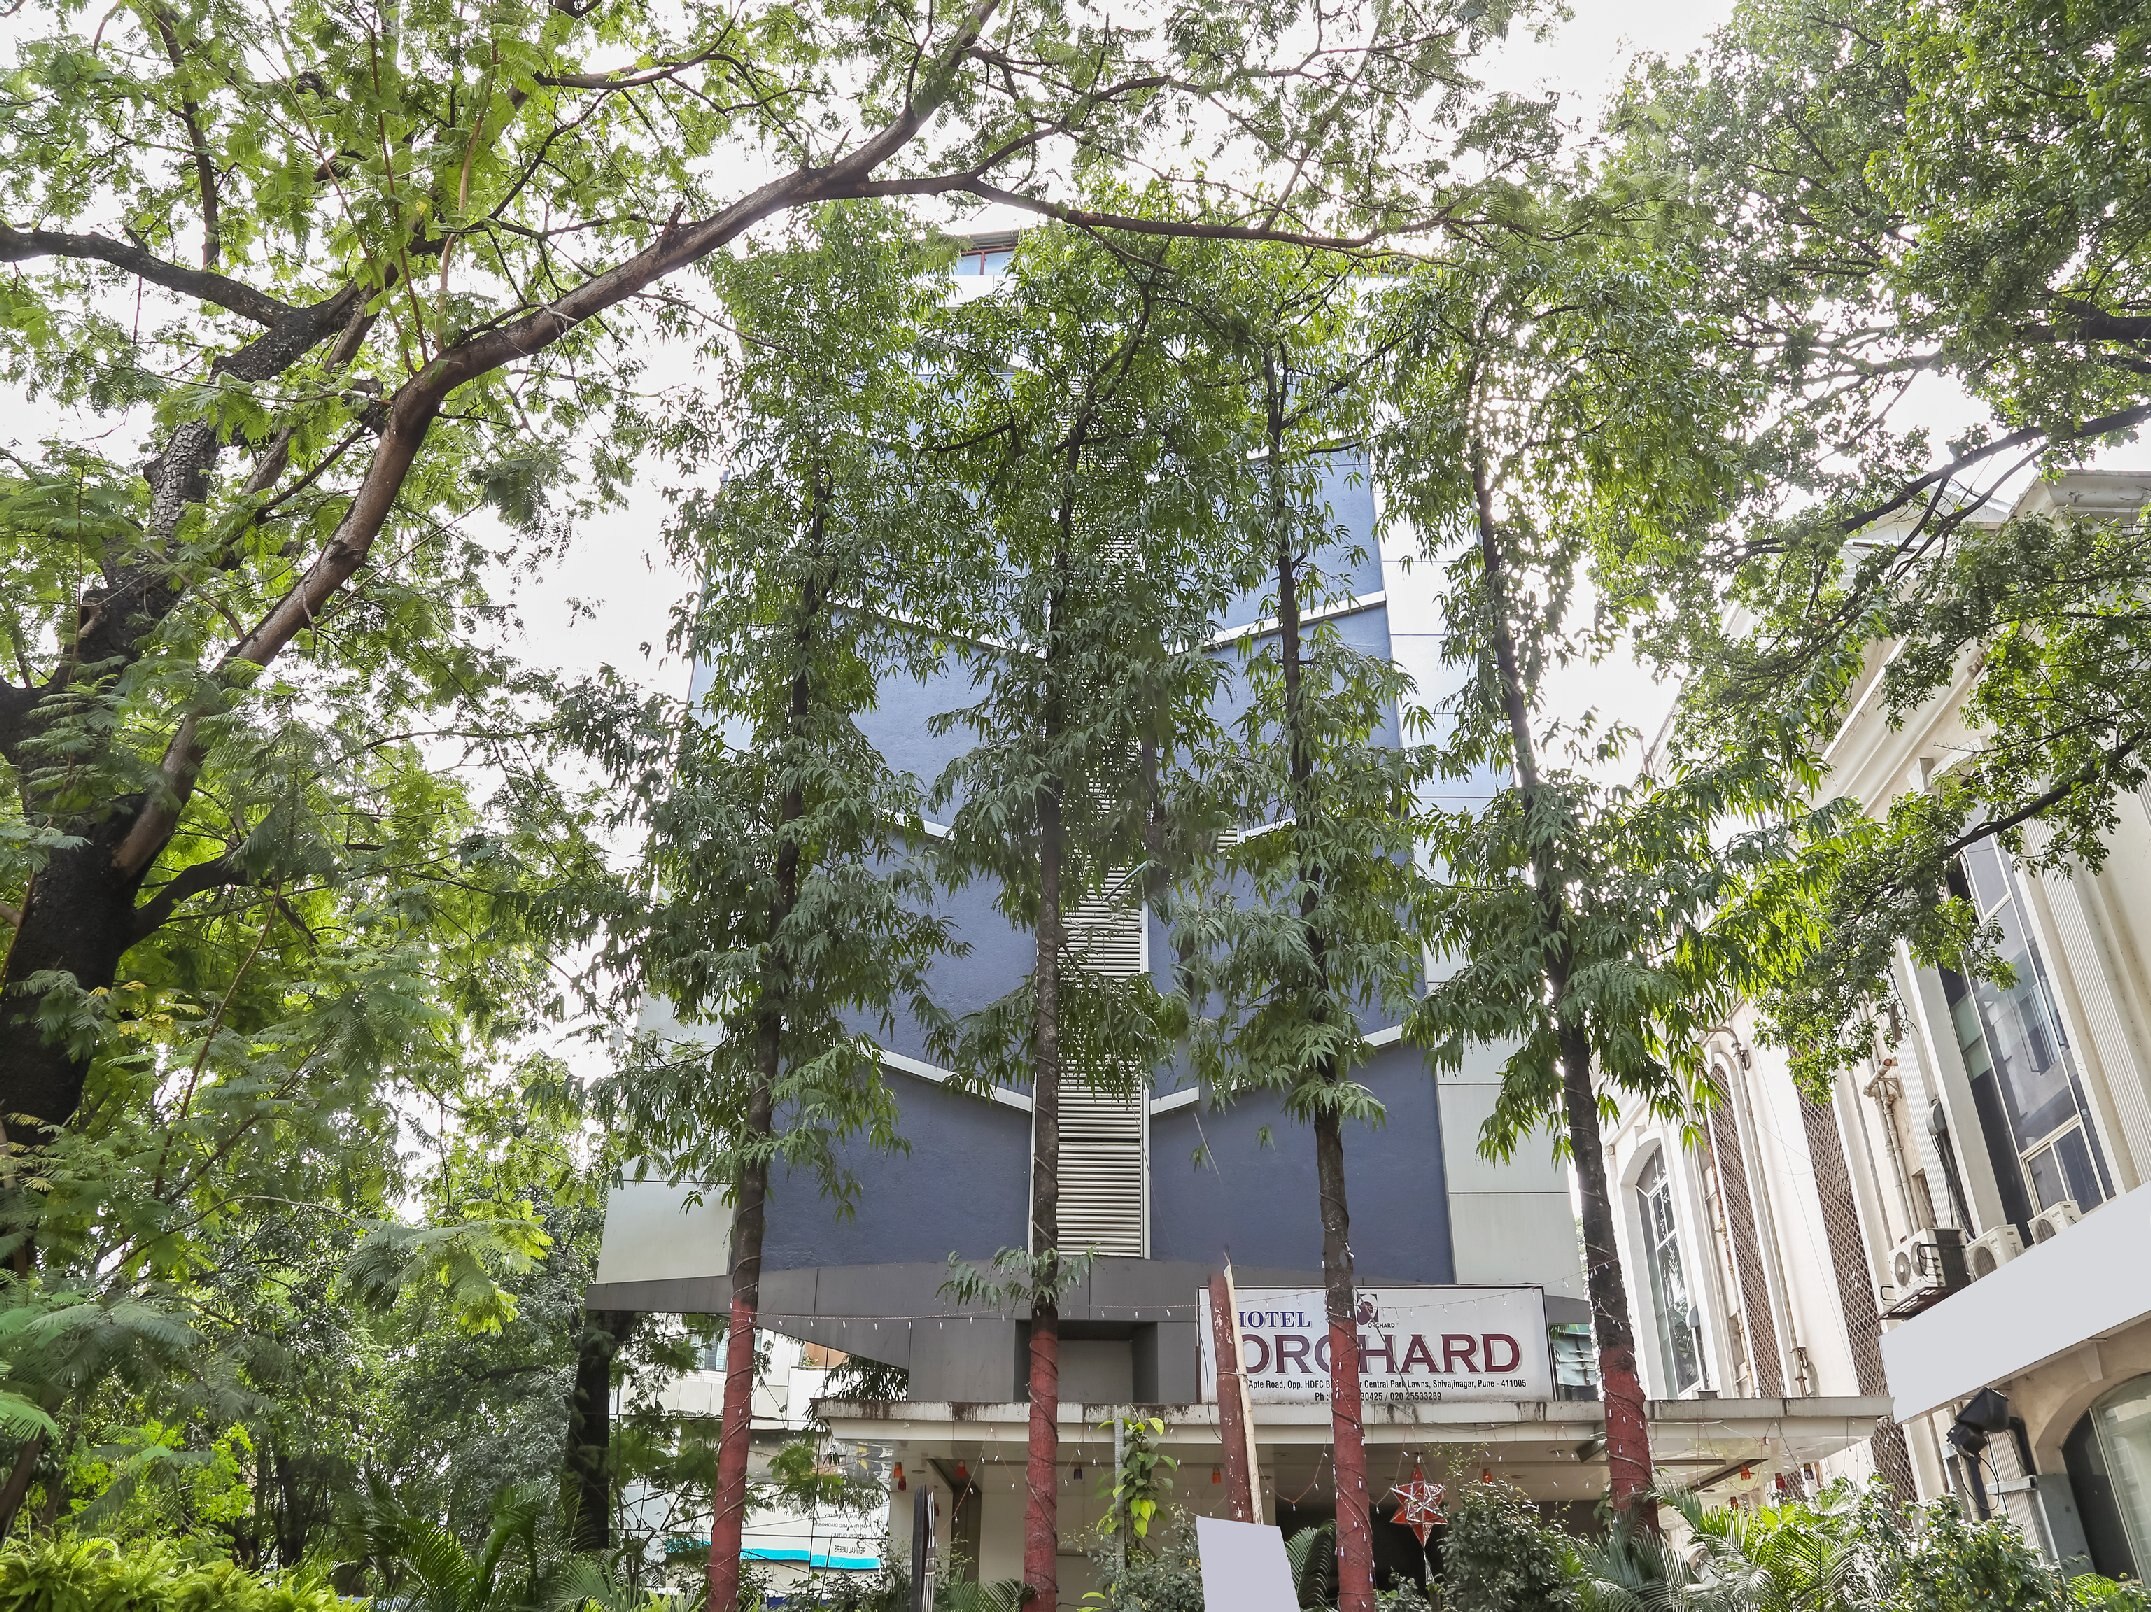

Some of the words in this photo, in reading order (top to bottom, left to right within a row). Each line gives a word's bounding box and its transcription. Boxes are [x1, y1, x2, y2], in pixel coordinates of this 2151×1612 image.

[1287, 1379, 1303, 1390] Opp.
[1305, 1379, 1324, 1389] HDFC
[1364, 1379, 1389, 1389] Central
[1390, 1379, 1407, 1389] Park
[1477, 1379, 1495, 1388] Pune
